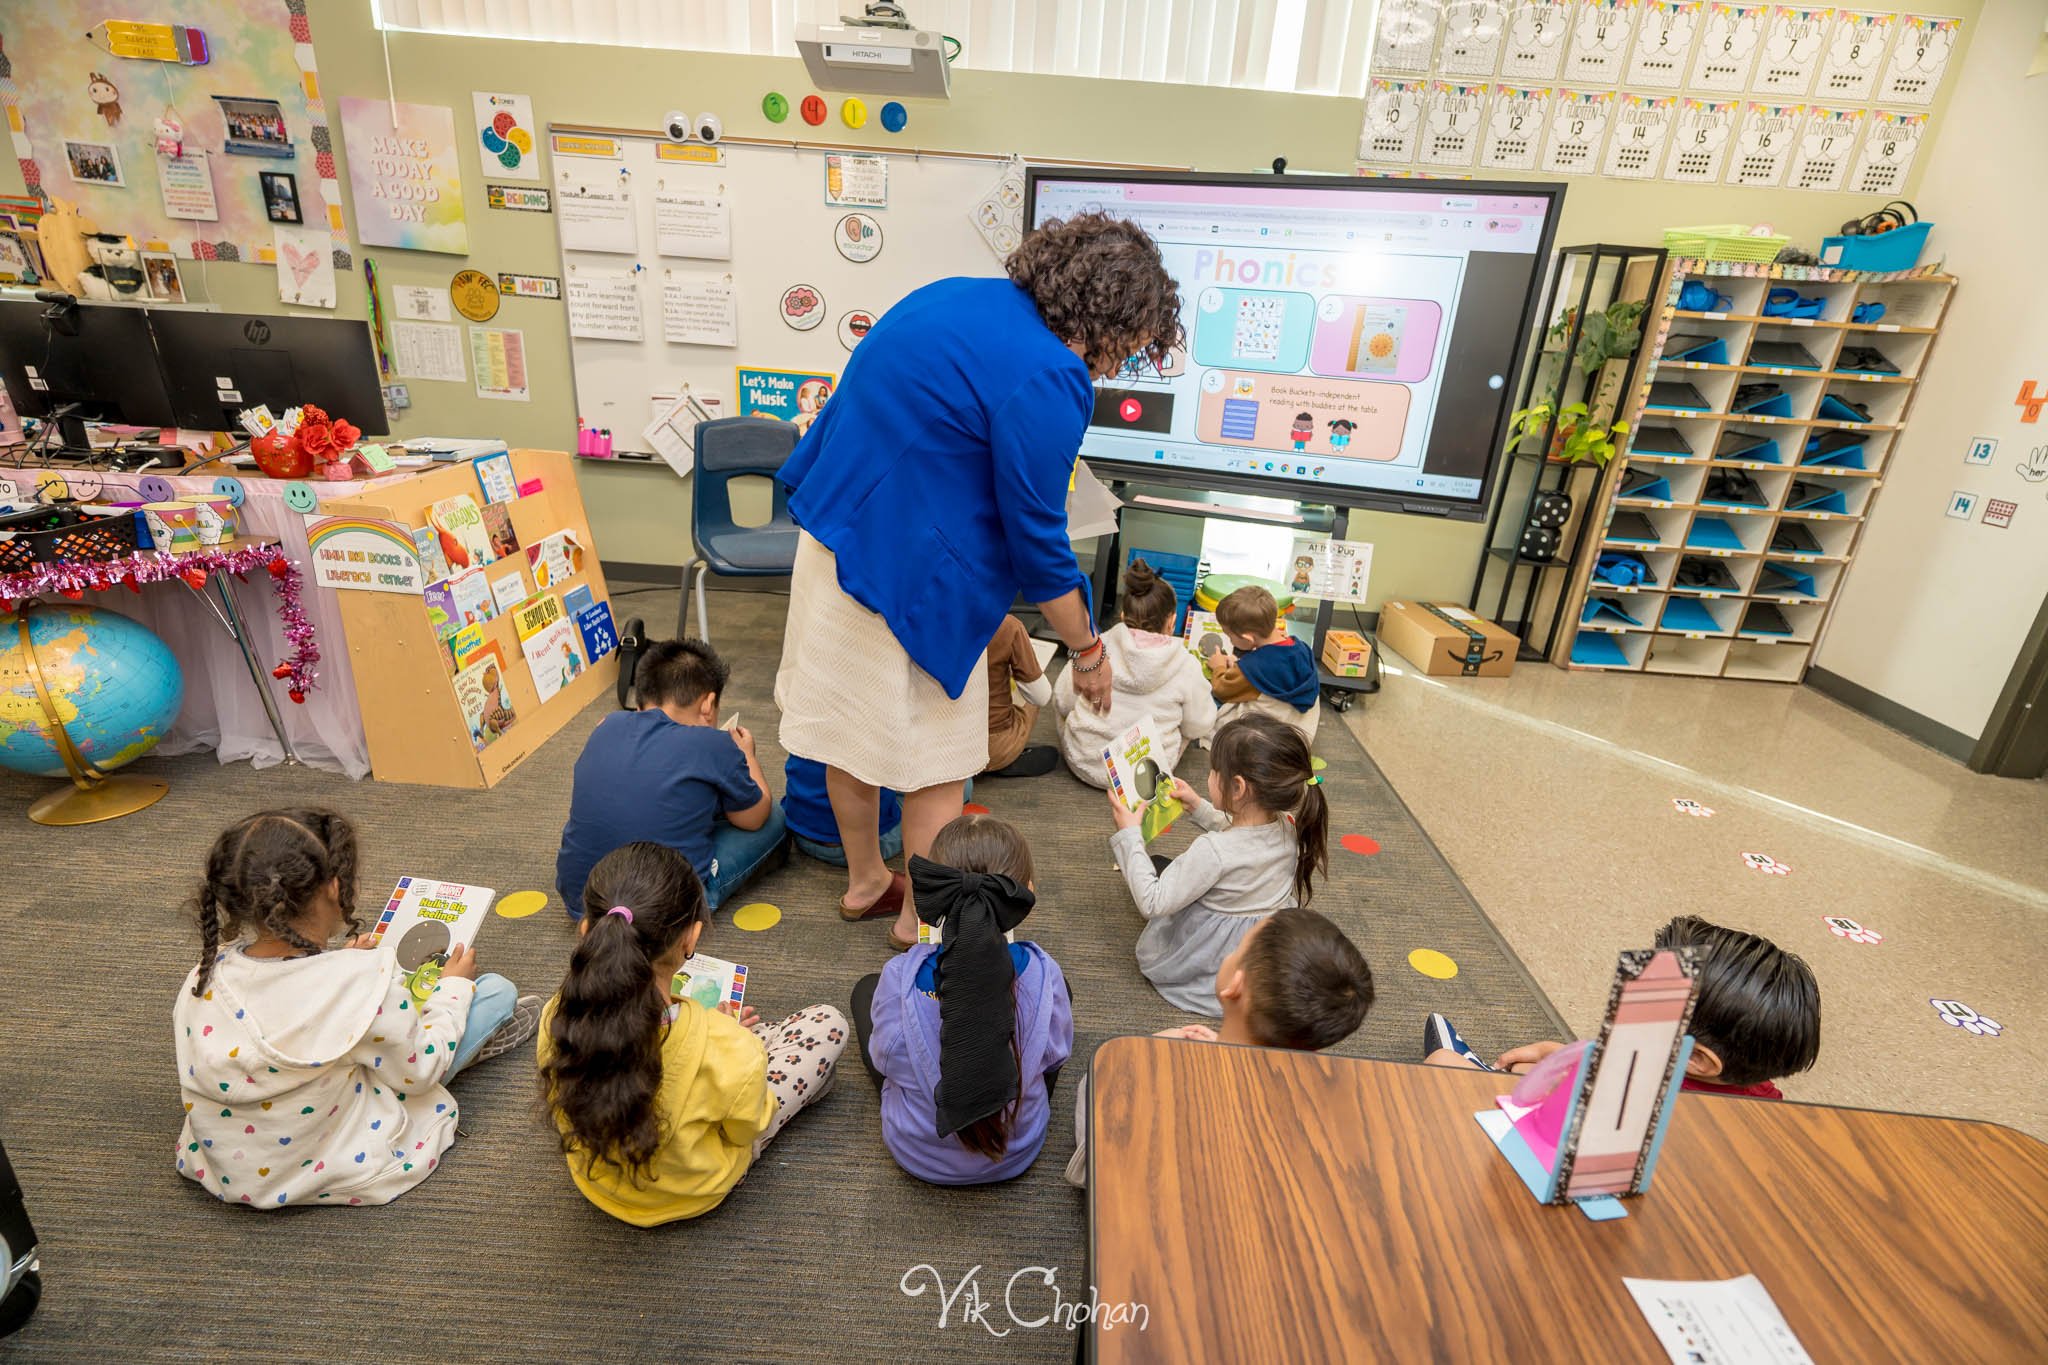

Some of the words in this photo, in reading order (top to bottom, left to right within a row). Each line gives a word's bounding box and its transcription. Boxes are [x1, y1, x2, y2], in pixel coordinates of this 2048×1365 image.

[1597, 28, 1606, 41] 4
[1659, 31, 1668, 46] 5
[1785, 23, 1810, 40] SEVEN
[1724, 35, 1732, 51] 6
[1789, 39, 1798, 55] 7
[1915, 33, 1934, 49] NINE
[852, 50, 882, 59] HITACHI
[1850, 45, 1860, 59] 8
[1916, 48, 1925, 62] 9
[770, 96, 780, 117] 3
[1389, 94, 1402, 107] TEN
[1443, 98, 1469, 113] ELEVEN
[808, 100, 818, 122] 4
[1386, 109, 1400, 123] 10
[1506, 101, 1533, 117] TWELVE
[1567, 104, 1600, 121] THIRTEEN
[1448, 114, 1457, 126] 11
[1509, 116, 1523, 130] 12
[1624, 111, 1662, 127] FOURTEEN
[1691, 114, 1720, 129] FIFTEEN
[1754, 118, 1786, 133] SIXTEEN
[1570, 121, 1585, 135] 13
[1633, 126, 1645, 139] 14
[1810, 122, 1850, 137] SEVENTEEN
[1878, 127, 1911, 141] EIGHTEEN
[1695, 129, 1707, 144] 15
[1758, 134, 1771, 148] 16
[372, 136, 429, 159] MAKE
[1821, 138, 1834, 151] 17
[1882, 141, 1895, 156] 18
[371, 159, 432, 181] TODAY
[373, 181, 387, 199] A
[391, 183, 440, 203] GOOD
[506, 192, 547, 206] READING
[391, 205, 427, 223] DAY
[1193, 249, 1337, 287] Phonics
[520, 279, 553, 294] MATH
[245, 320, 269, 344] hp
[742, 374, 767, 389] Let's
[768, 377, 794, 390] Make
[1208, 375, 1219, 387] 3.
[750, 389, 788, 407] Music
[1271, 386, 1287, 395] Book
[1269, 399, 1295, 409] reading
[1296, 400, 1310, 408] with
[1312, 401, 1336, 411] buddies
[1347, 404, 1359, 412] the
[1360, 405, 1378, 414] table
[1973, 443, 1991, 459] 13
[2029, 468, 2046, 477] her
[1954, 497, 1969, 513] 14
[445, 504, 480, 531] DRAGONS
[1308, 543, 1318, 551] At
[1337, 544, 1355, 557] Rug
[524, 602, 548, 631] SCHOOL
[546, 597, 558, 619] BUS
[457, 637, 481, 658] Weather
[535, 645, 551, 660] Went
[549, 625, 571, 646] Walking
[458, 680, 469, 693] How
[468, 676, 477, 685] Do
[1677, 800, 1699, 808] 20
[1750, 854, 1770, 864] 19
[419, 898, 449, 910] Hulk's
[449, 902, 467, 914] Big
[417, 908, 459, 923] Feelings
[1832, 919, 1858, 930] 18
[1942, 1003, 1973, 1017] 17
